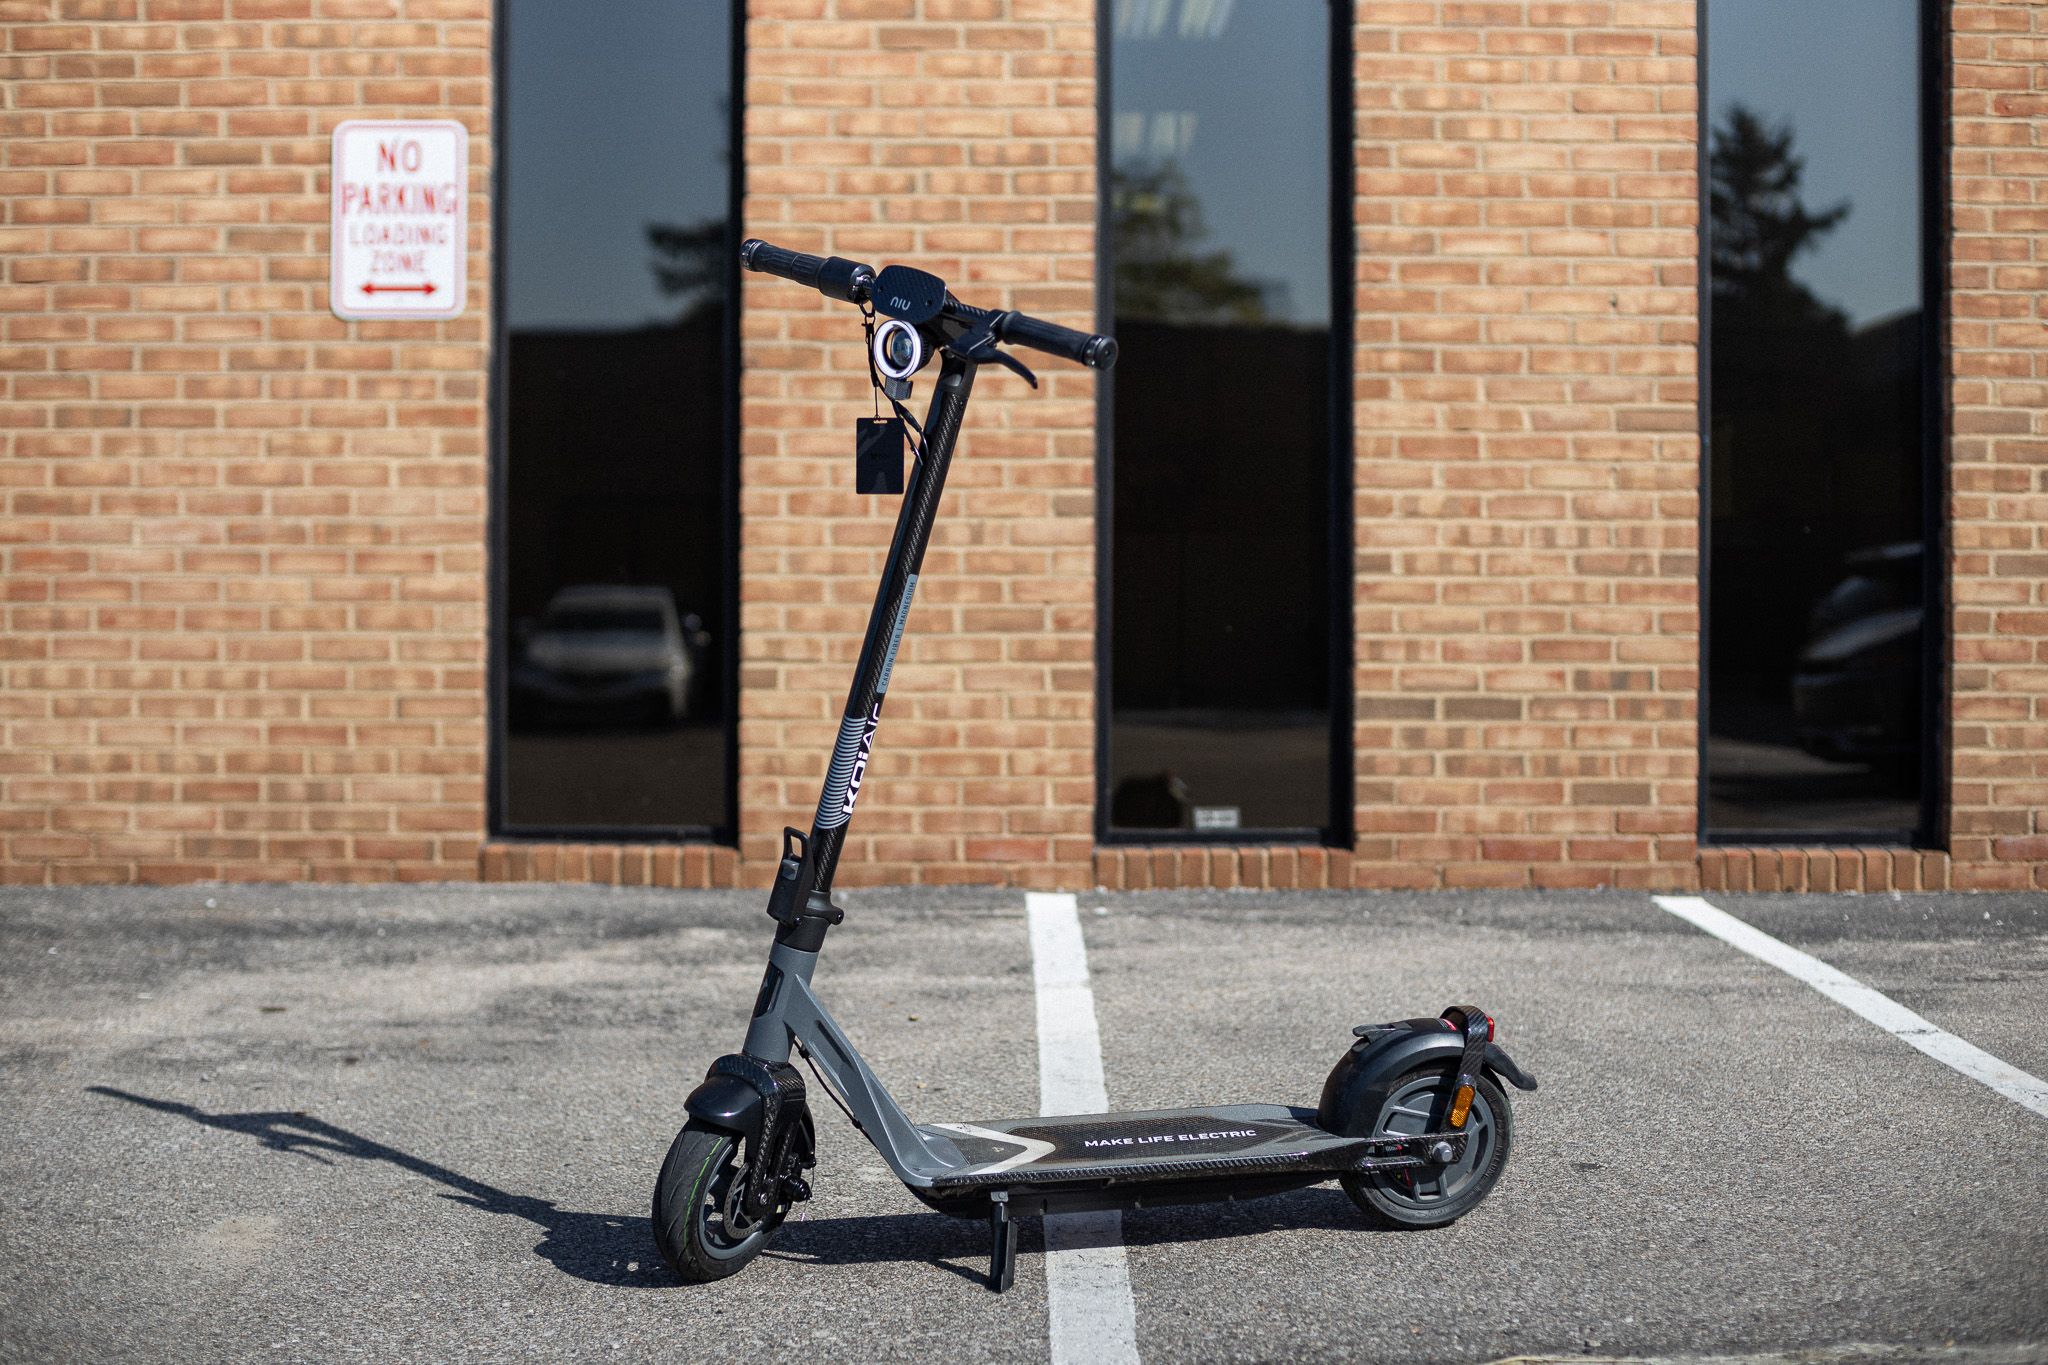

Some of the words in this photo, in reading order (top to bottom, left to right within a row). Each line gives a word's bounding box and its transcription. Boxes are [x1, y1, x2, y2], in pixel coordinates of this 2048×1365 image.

[377, 140, 423, 172] NO
[340, 182, 459, 214] PARKING
[349, 223, 448, 245] LOADING
[370, 250, 424, 273] ZONE
[881, 657, 894, 686] CARBON
[891, 634, 902, 656] FIBER
[899, 582, 916, 625] MAGNESIUM
[1084, 1138, 1134, 1148] MAKE
[1138, 1135, 1174, 1144] LIFE
[1179, 1130, 1257, 1141] ELECTRIC
